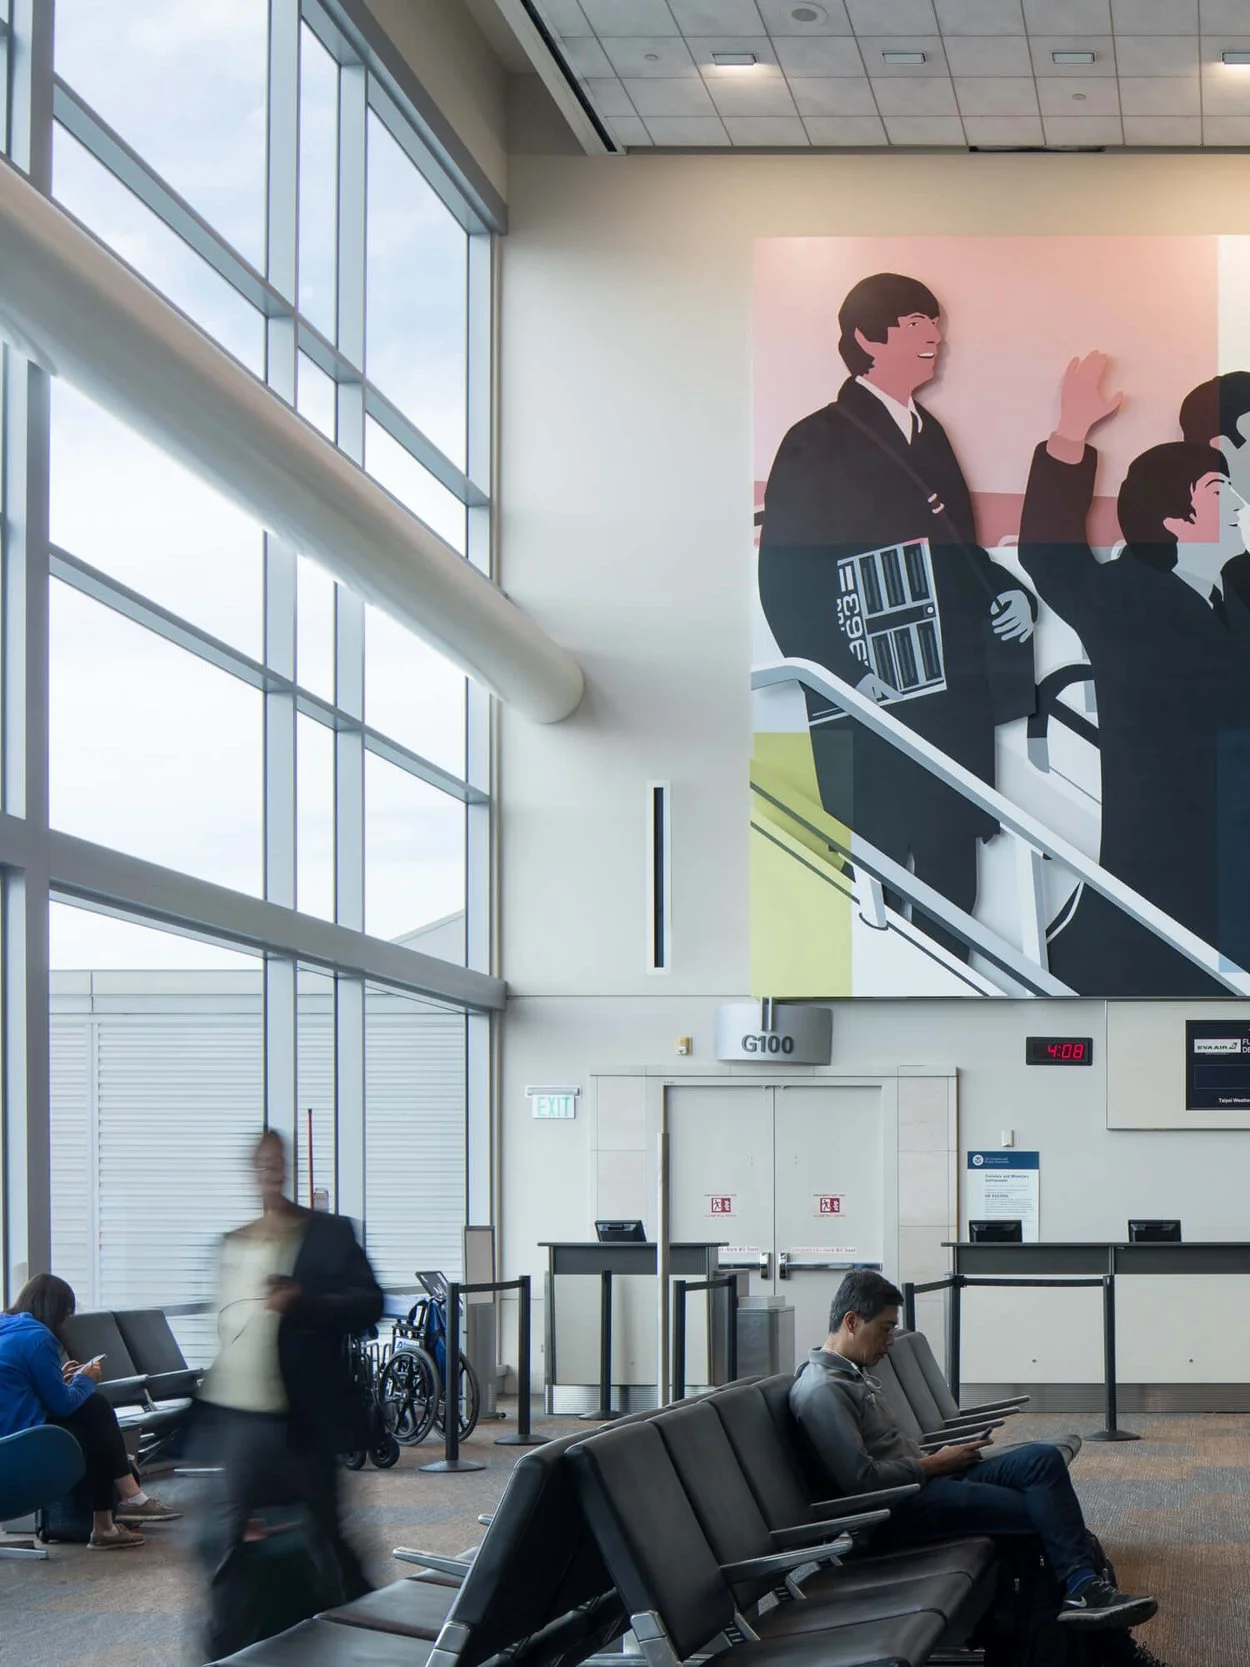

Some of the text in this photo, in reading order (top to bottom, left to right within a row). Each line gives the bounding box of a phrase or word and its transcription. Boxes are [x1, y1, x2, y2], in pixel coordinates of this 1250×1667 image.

[741, 1034, 794, 1054] G100
[1047, 1043, 1084, 1059] 4:08
[537, 1096, 570, 1117] EXIT
